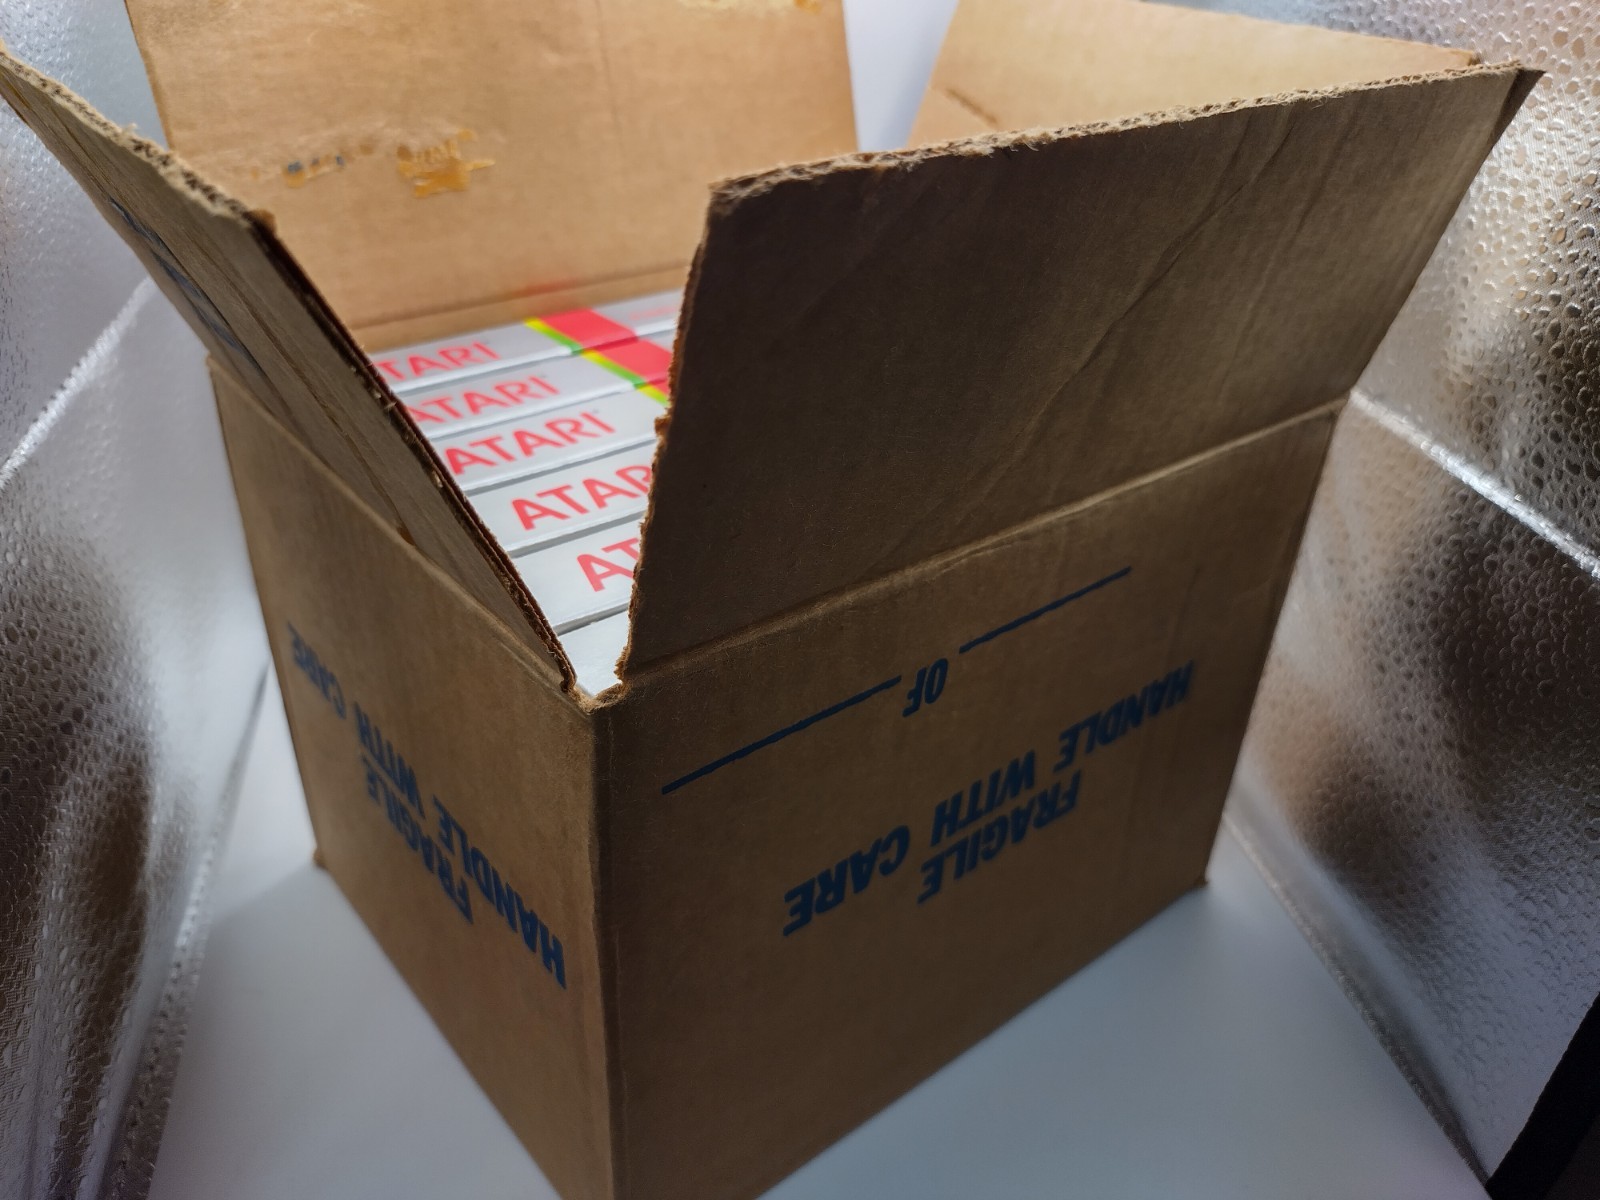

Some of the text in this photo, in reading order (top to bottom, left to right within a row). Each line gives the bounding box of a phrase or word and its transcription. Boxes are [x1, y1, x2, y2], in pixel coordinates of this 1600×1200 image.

[374, 340, 501, 381] TARI
[406, 375, 560, 424] ATARI
[444, 411, 616, 476] ATARI
[511, 464, 652, 531] ATAR
[902, 658, 949, 718] OF
[287, 620, 567, 991] HANDLE WITH CARE
[782, 658, 1195, 937] HANDLE WITH CARE
[361, 752, 475, 926] FRAGILE
[916, 769, 1082, 905] FRAGILE
